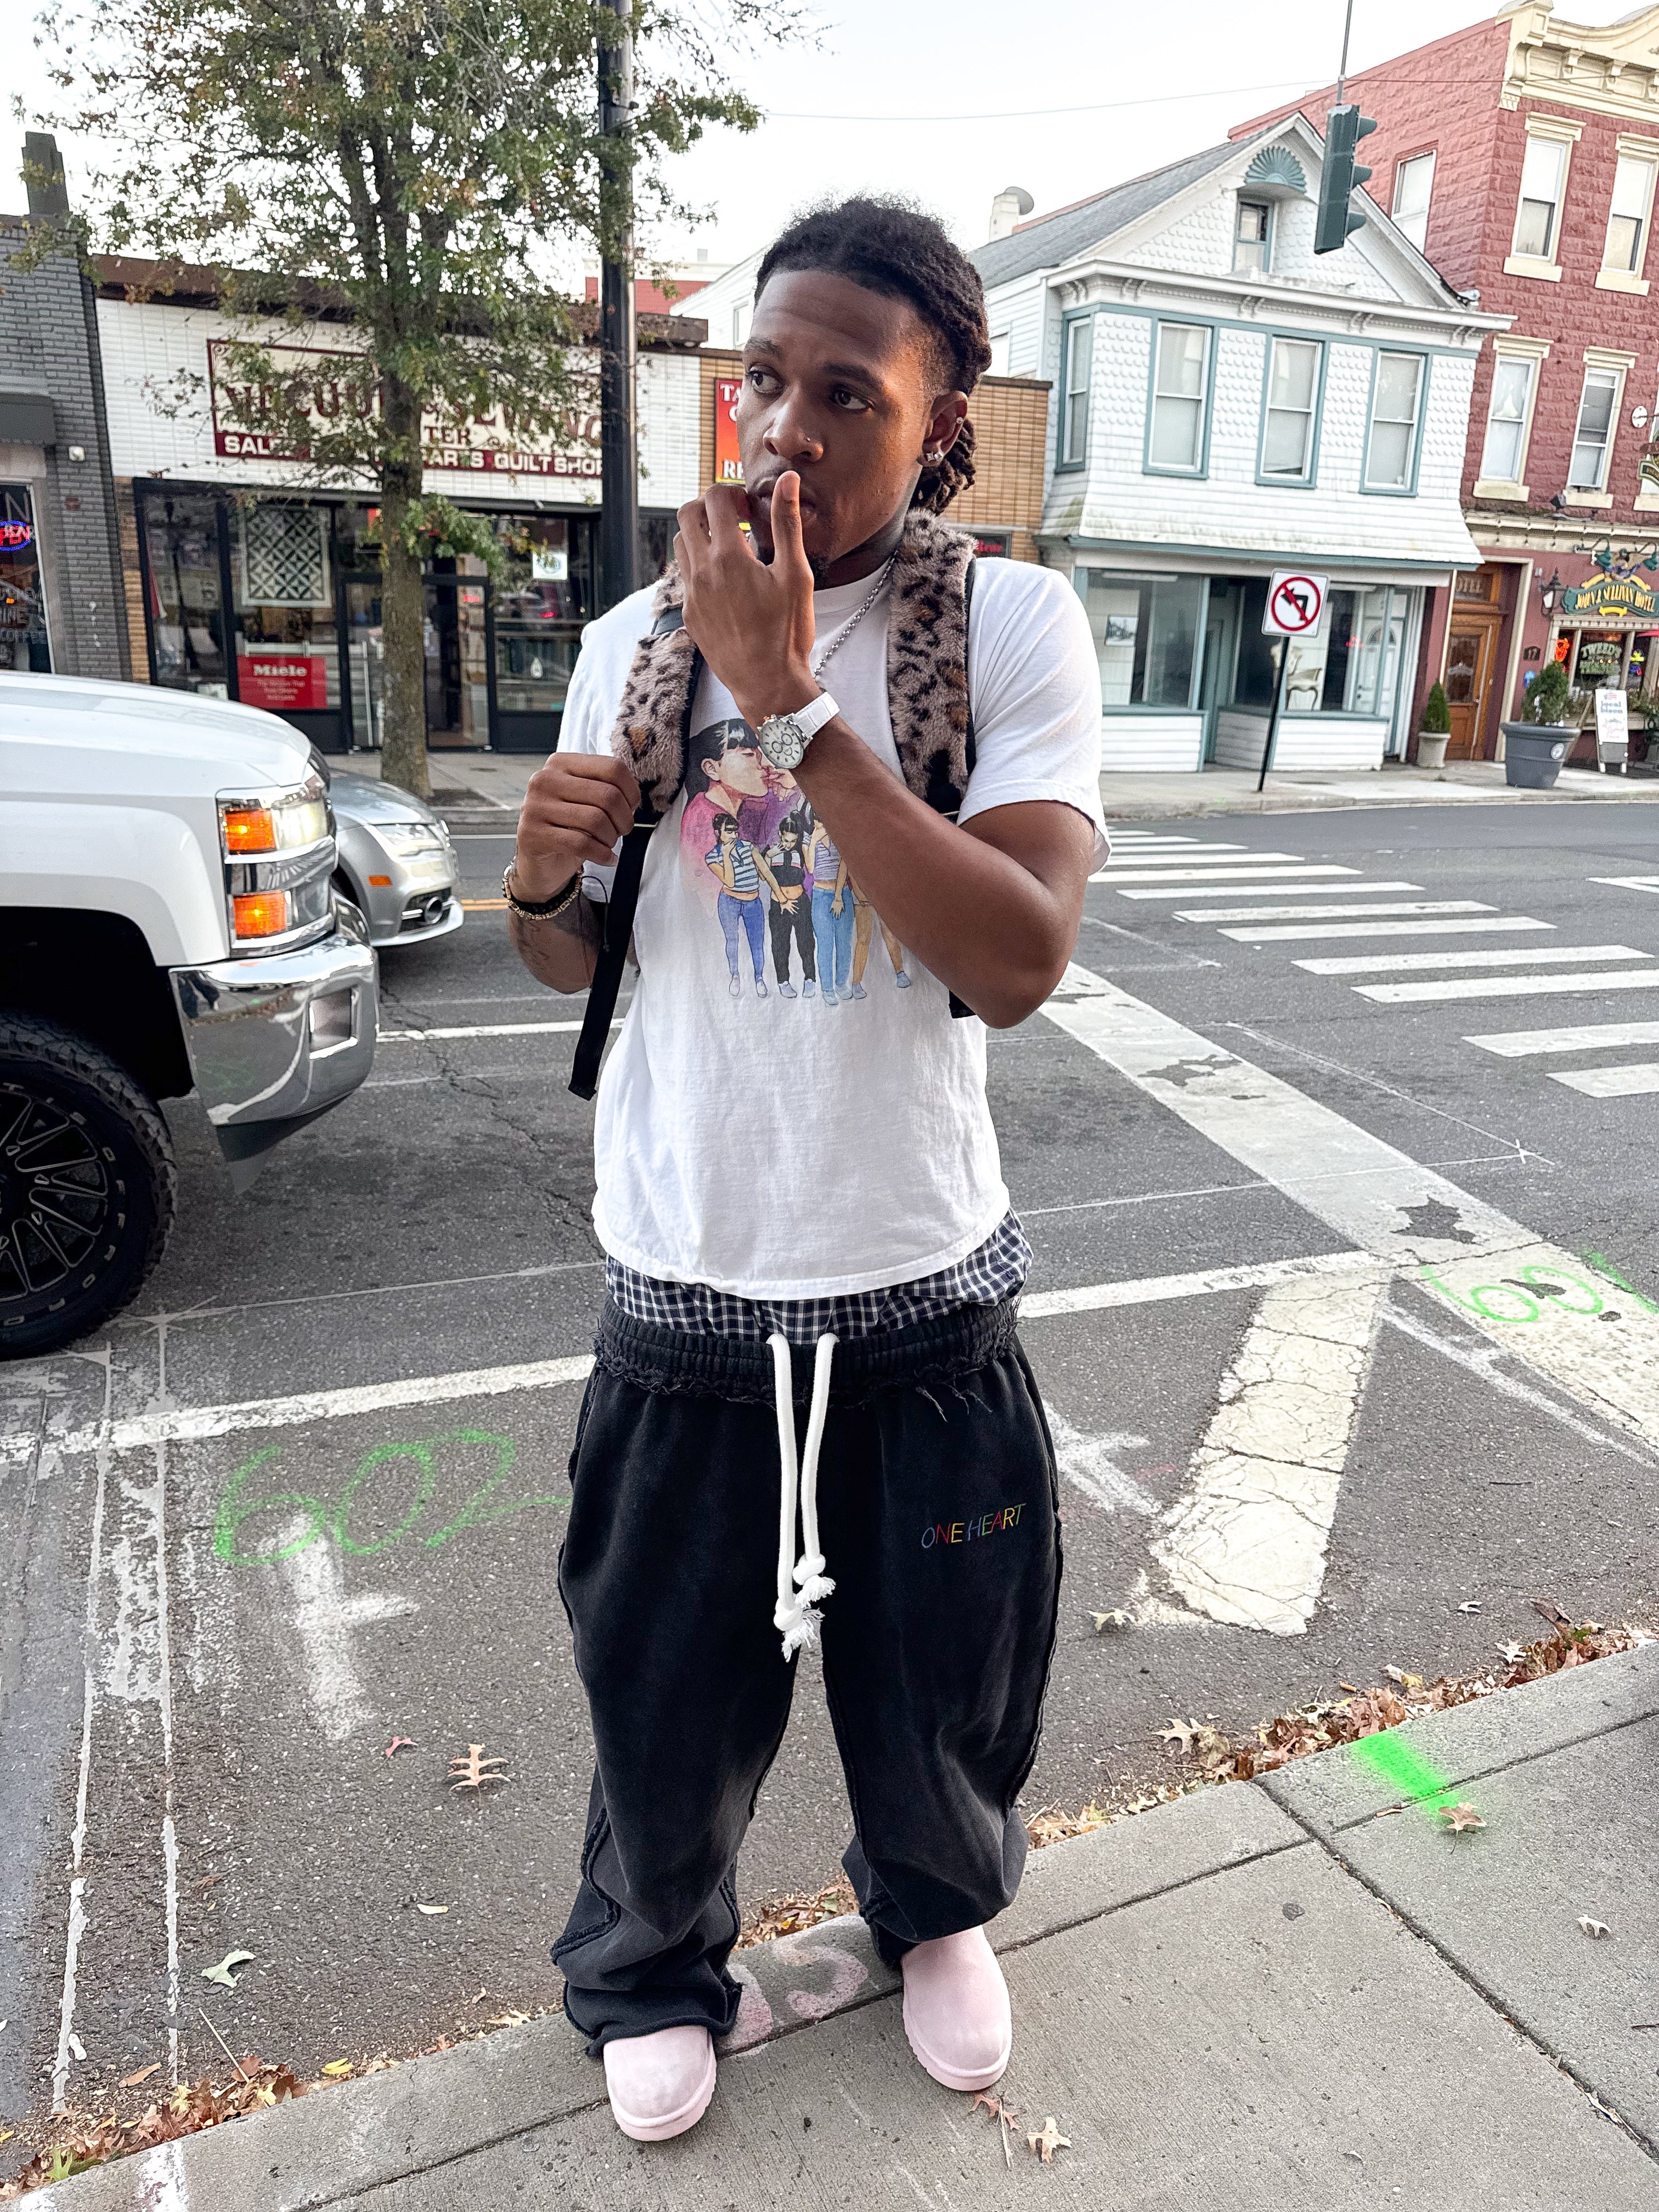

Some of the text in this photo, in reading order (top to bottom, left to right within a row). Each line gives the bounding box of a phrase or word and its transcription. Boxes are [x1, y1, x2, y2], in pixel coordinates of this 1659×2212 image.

[494, 452, 552, 472] QUILT
[0, 525, 30, 546] PEN
[1455, 577, 1485, 594] OTEL
[1575, 591, 1595, 610] JOHN
[1603, 584, 1634, 604] SULLIVAN
[1634, 590, 1656, 613] HOTEL
[253, 664, 307, 677] Miele
[214, 1429, 572, 1566] 602
[921, 1503, 1026, 1548] ONE HEART
